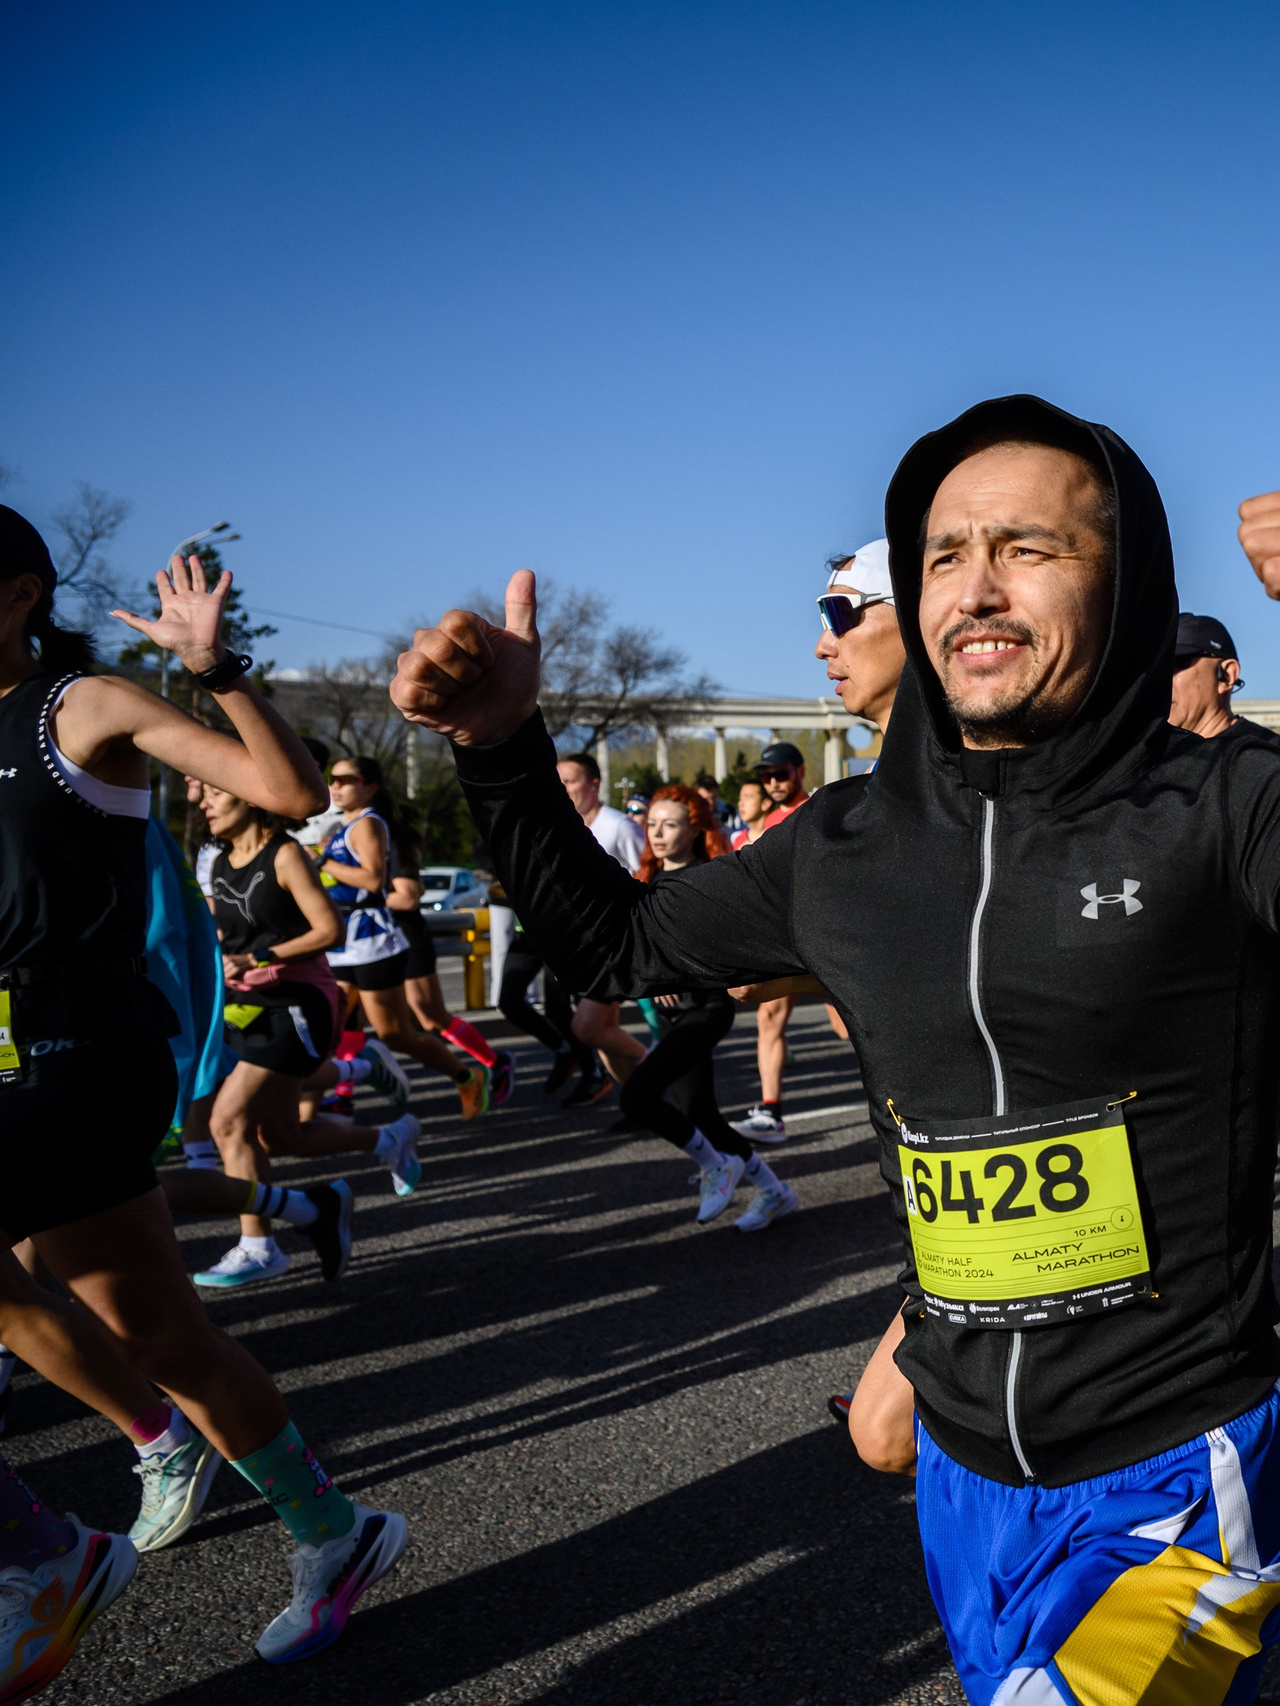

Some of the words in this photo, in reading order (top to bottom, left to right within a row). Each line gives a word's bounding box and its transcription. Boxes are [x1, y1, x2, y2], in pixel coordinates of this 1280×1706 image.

[43, 753, 74, 795] UNDER
[912, 1143, 1090, 1224] 6428
[907, 1180, 916, 1210] A
[1074, 1229, 1087, 1237] 10
[1090, 1225, 1107, 1235] KM
[921, 1251, 945, 1265] ALMATY
[948, 1257, 972, 1266] HALF
[1012, 1242, 1083, 1261] ALMATY
[1037, 1245, 1140, 1273] MARATHON
[923, 1262, 962, 1278] MARATHON
[965, 1269, 994, 1278] 2024
[1080, 1288, 1103, 1298] UNDER
[1103, 1281, 1132, 1294] ARMOUR
